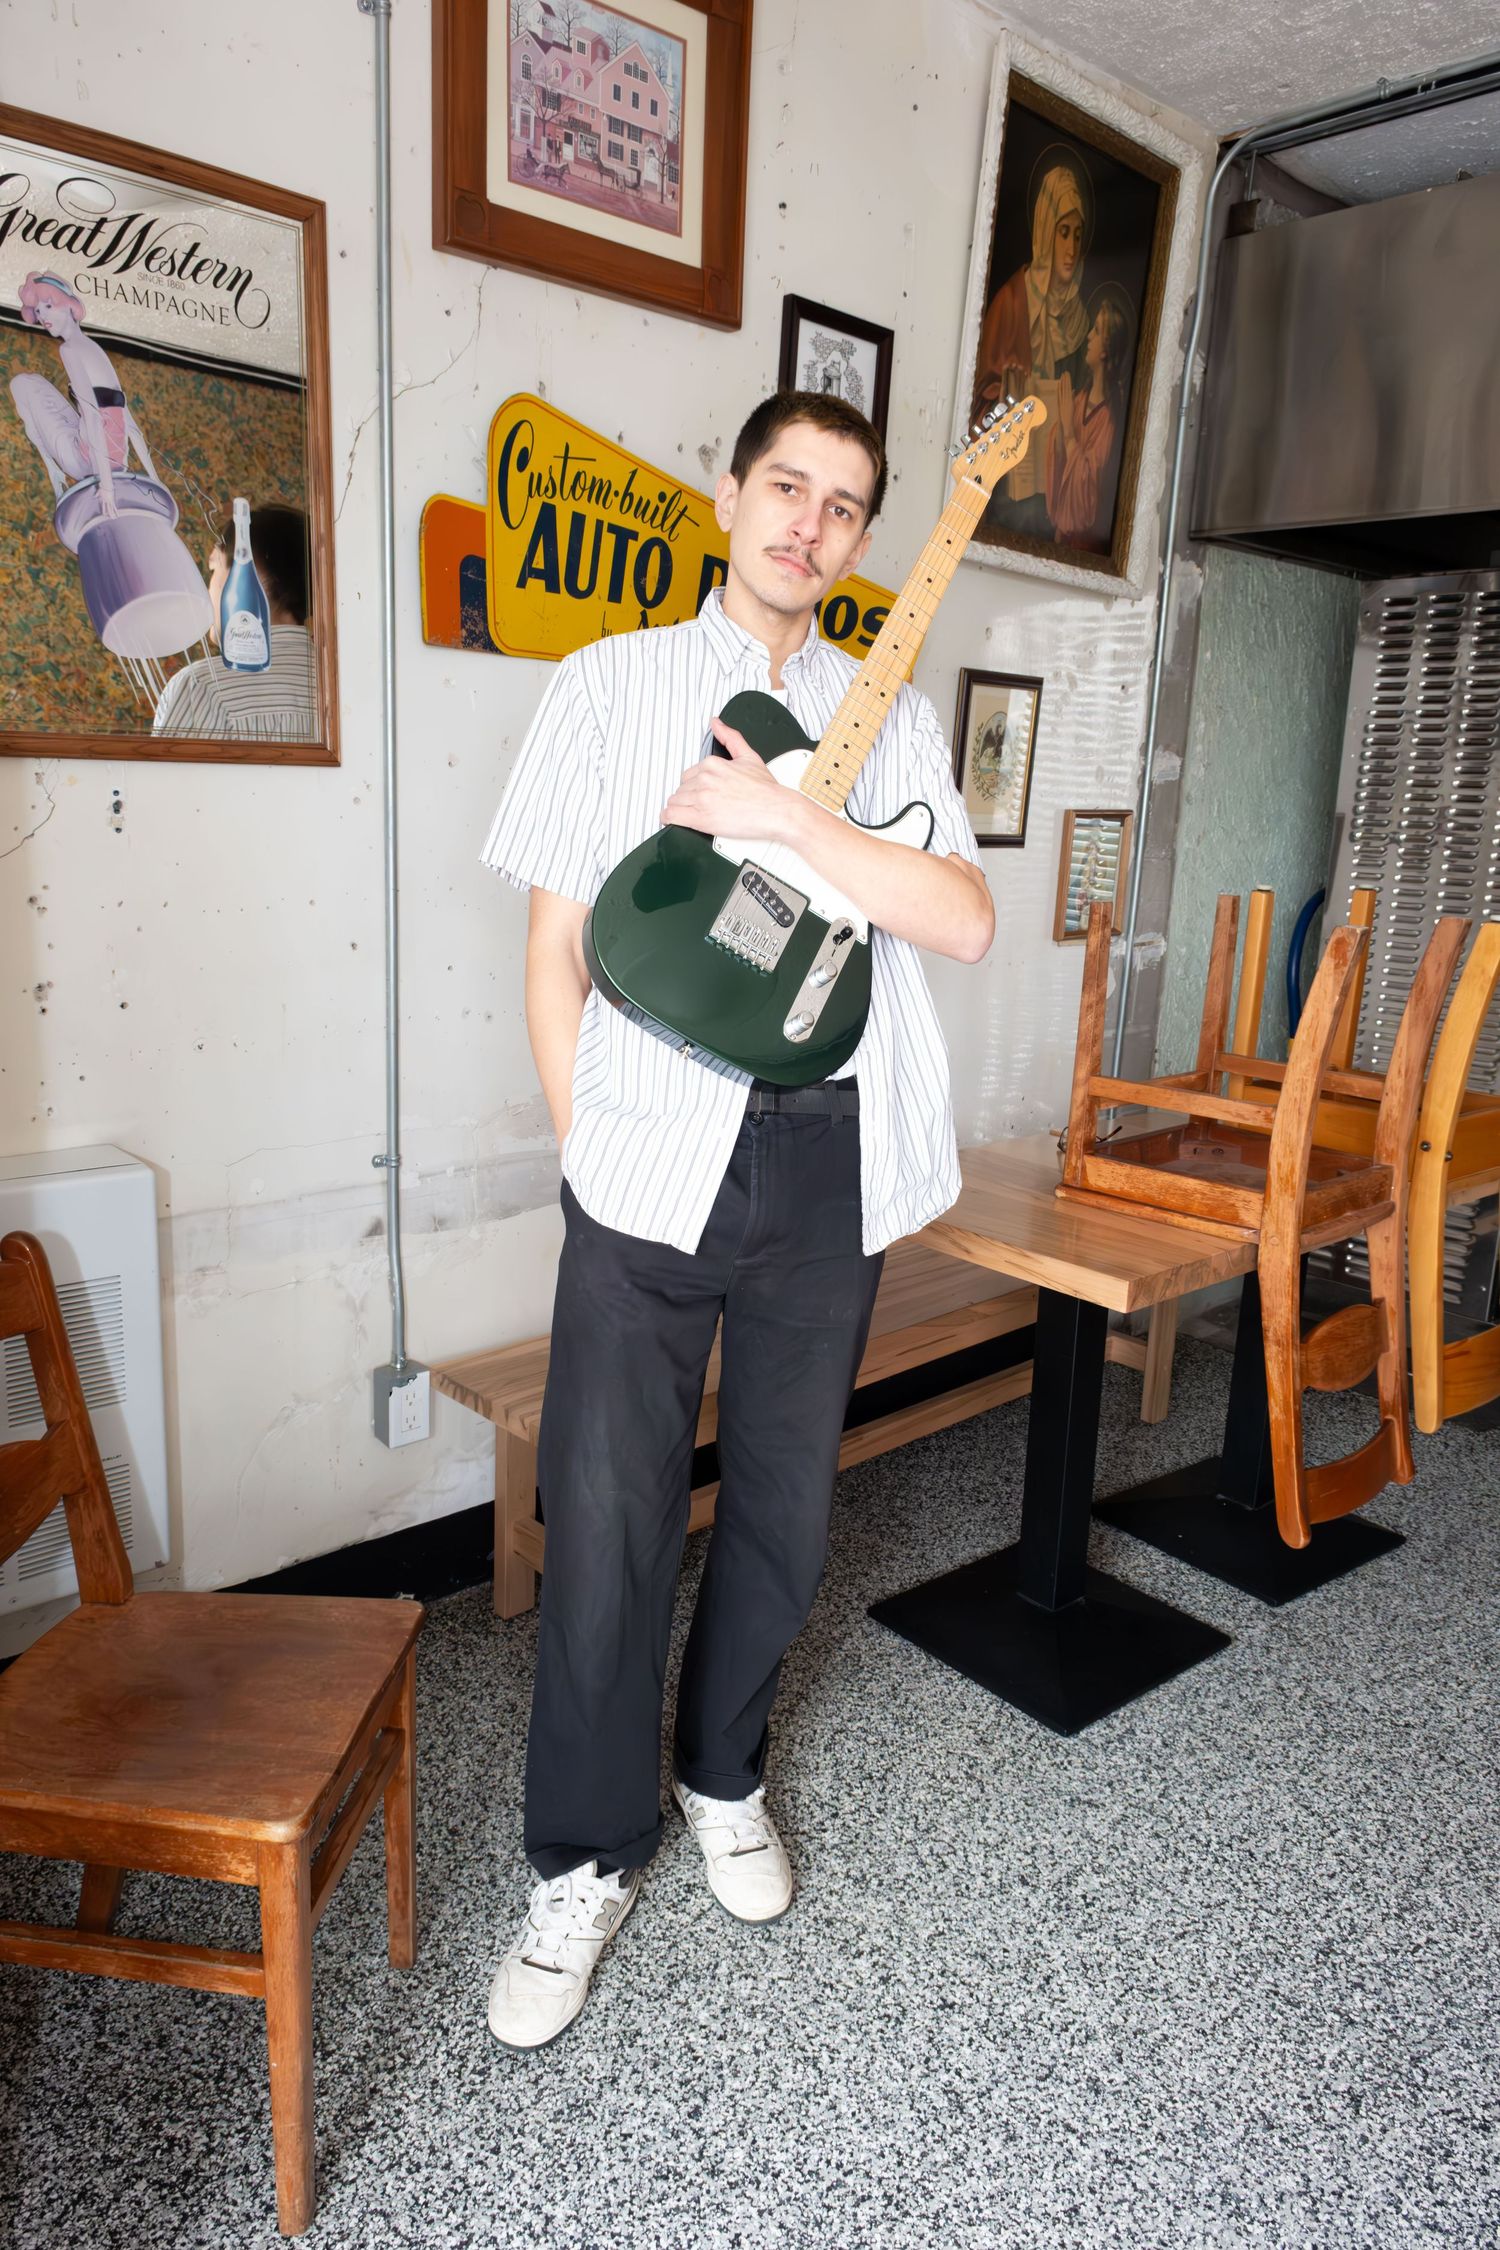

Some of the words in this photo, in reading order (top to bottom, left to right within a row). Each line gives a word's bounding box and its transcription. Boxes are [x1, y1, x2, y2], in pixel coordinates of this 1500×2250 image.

[56, 176, 271, 330] Western
[73, 272, 232, 327] CHAMPAGNE
[515, 500, 674, 610] AUTO
